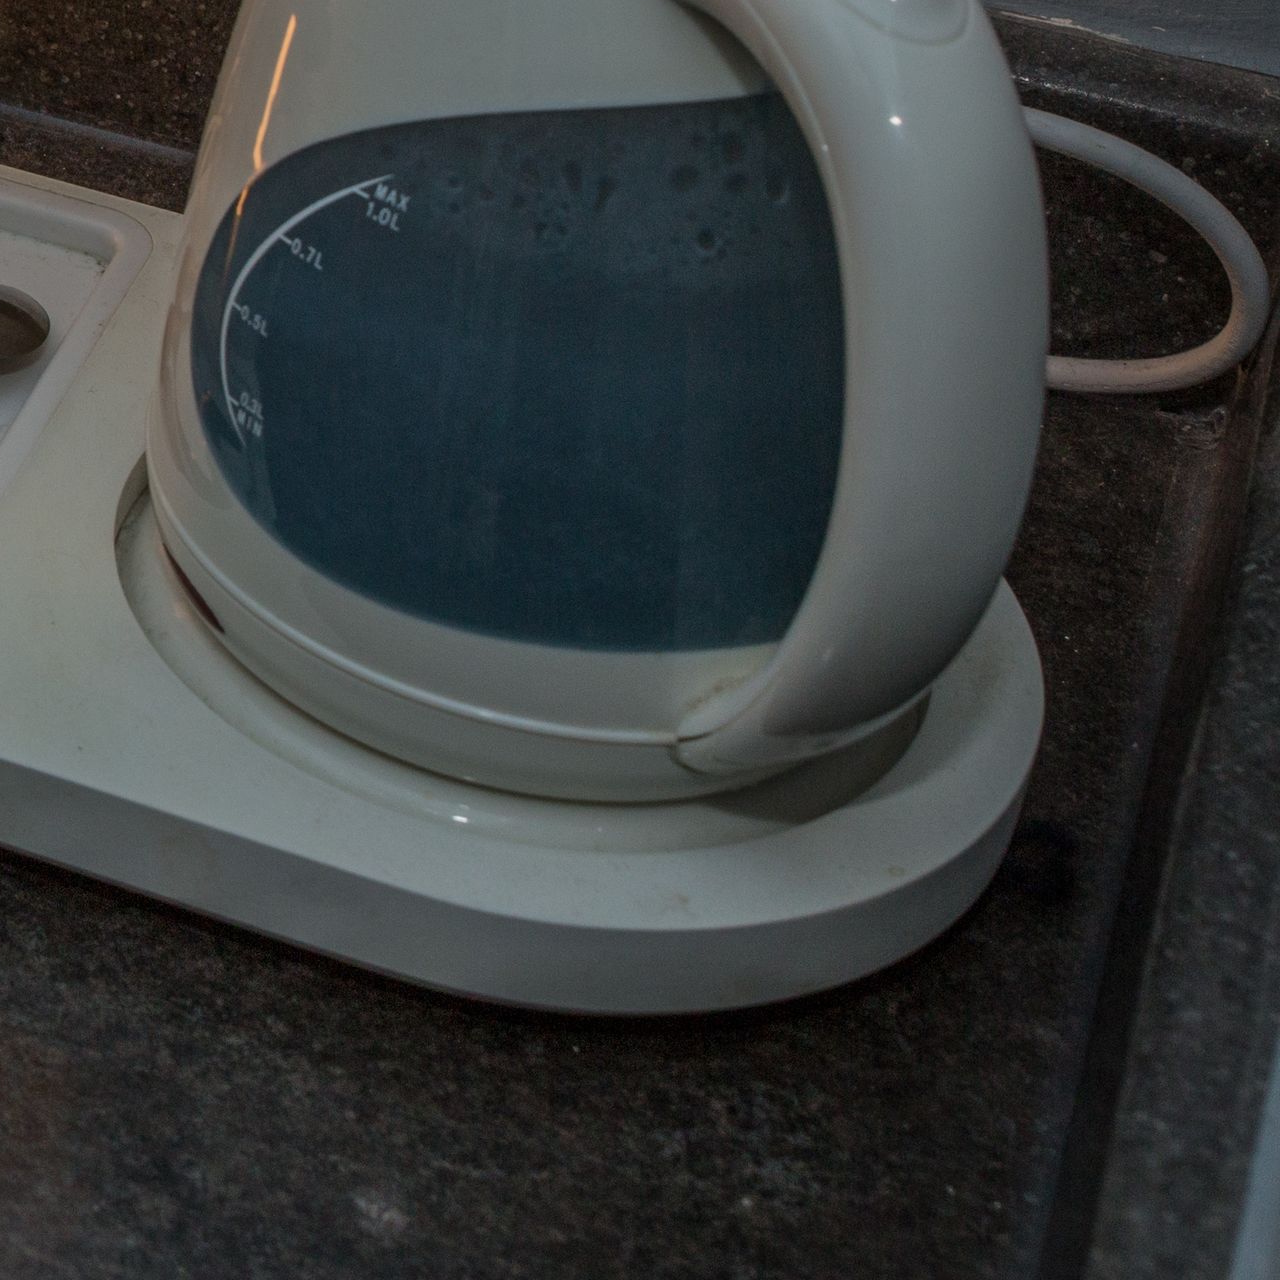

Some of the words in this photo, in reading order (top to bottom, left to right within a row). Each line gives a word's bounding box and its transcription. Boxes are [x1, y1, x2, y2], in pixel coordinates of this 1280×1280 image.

[373, 183, 412, 213] MAX
[365, 201, 400, 232] 1.0L
[290, 237, 323, 271] 0.7L
[240, 304, 269, 338] 0.5L
[236, 408, 264, 438] MIN
